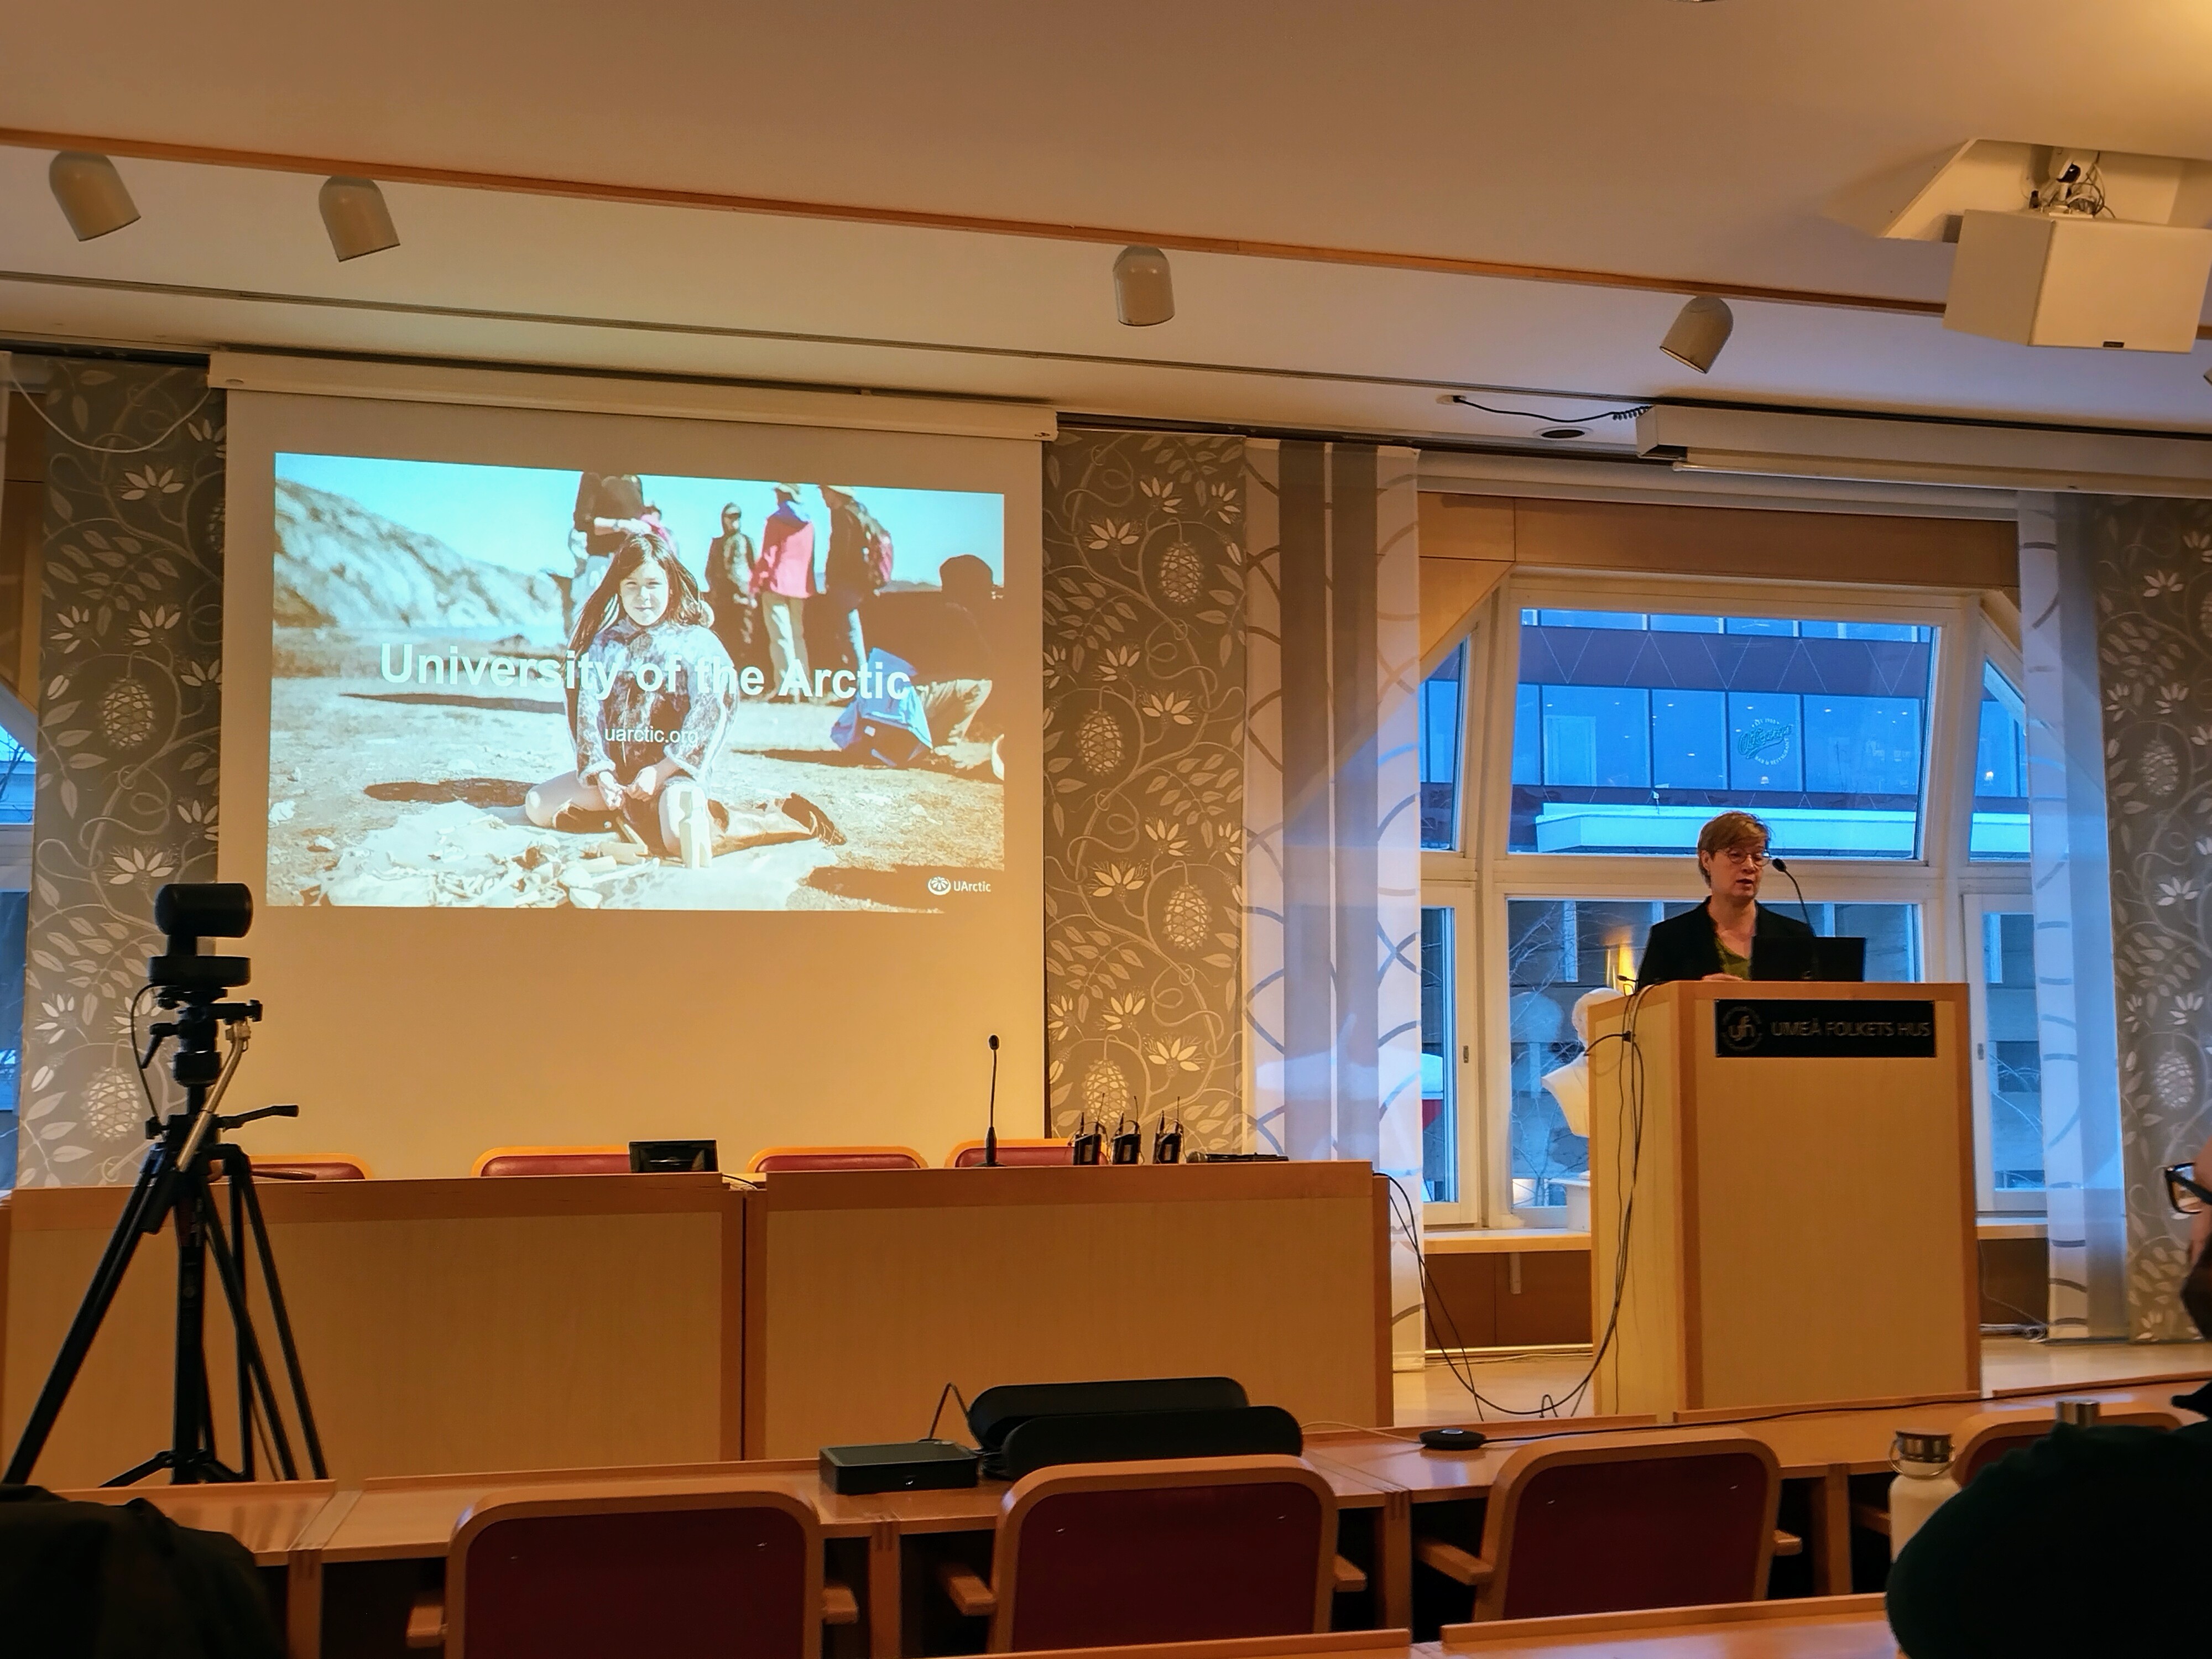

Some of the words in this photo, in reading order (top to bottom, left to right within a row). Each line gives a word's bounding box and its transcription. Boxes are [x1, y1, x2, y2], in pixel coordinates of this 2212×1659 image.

[380, 643, 619, 701] University
[635, 654, 682, 692] of
[695, 656, 765, 696] the
[778, 659, 911, 700] Arctic
[604, 725, 698, 747] uarctic.org
[953, 880, 992, 893] UArctic
[1770, 1017, 1821, 1037] UMEÅ
[1825, 1021, 1895, 1037] FOLKETS
[1897, 1021, 1932, 1037] HUS
